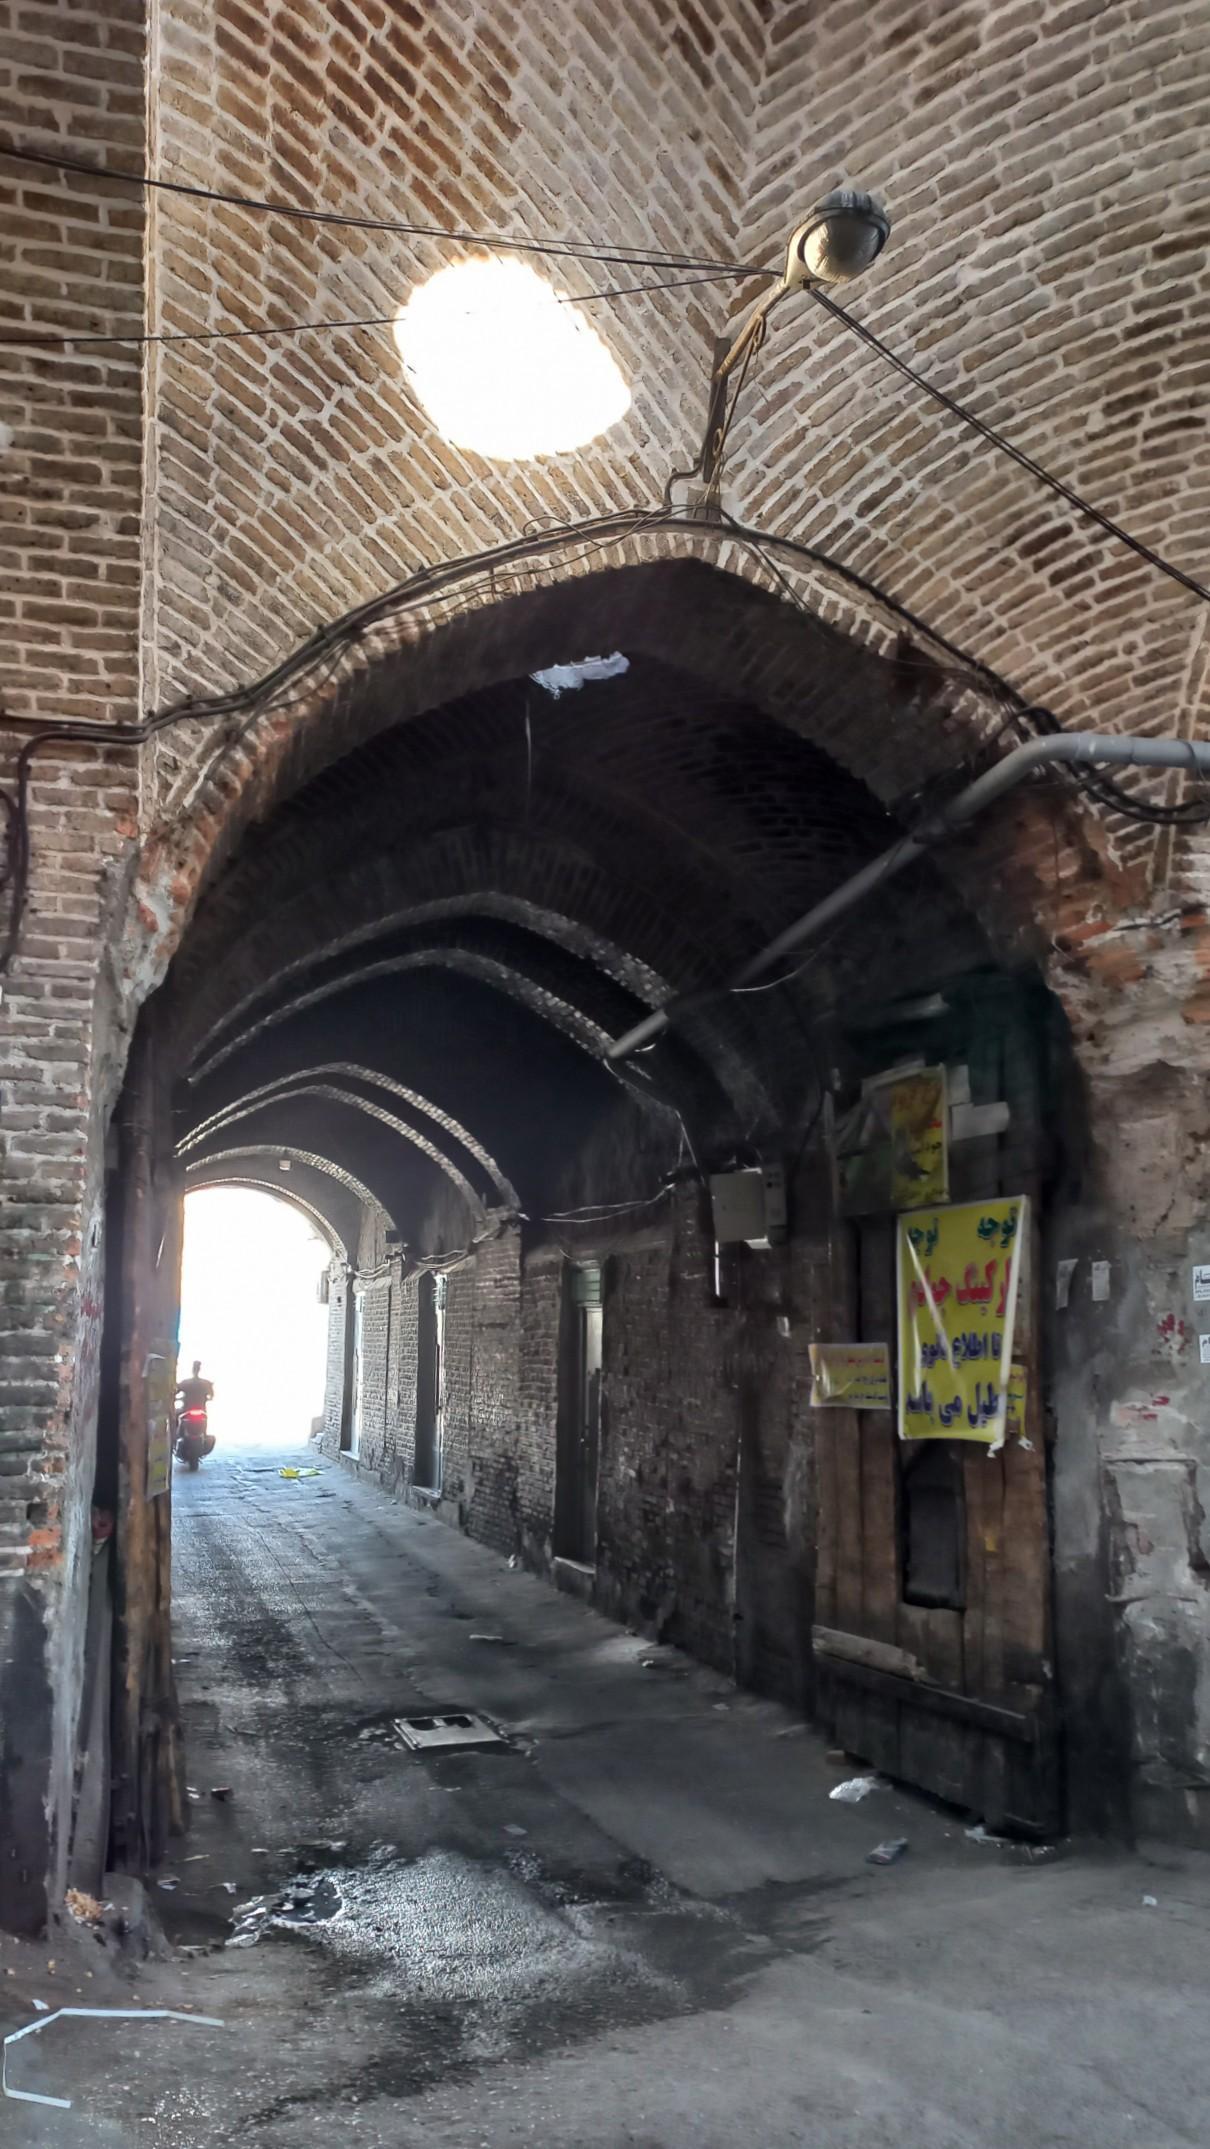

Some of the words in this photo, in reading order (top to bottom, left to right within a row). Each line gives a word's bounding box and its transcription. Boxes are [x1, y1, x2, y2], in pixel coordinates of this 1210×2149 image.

[977, 1206, 1018, 1249] توجه
[956, 1256, 1012, 1318] ارکینگ
[939, 1395, 963, 1428] می
[967, 1381, 999, 1429] طیل
